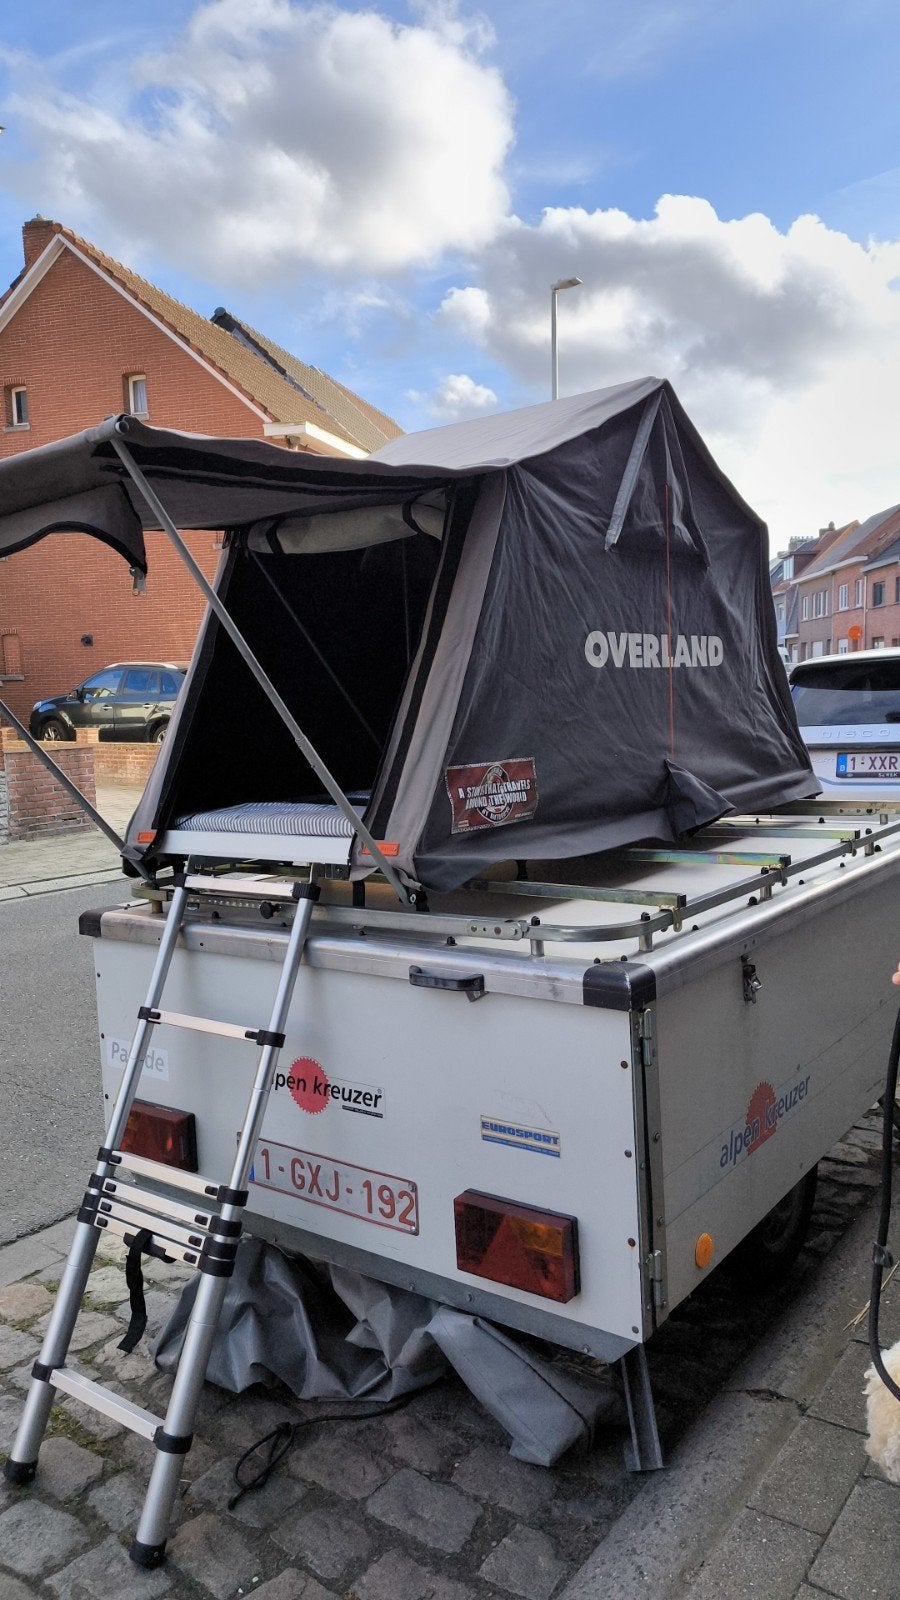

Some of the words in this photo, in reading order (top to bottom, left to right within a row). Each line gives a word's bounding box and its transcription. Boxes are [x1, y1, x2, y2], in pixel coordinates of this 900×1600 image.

[584, 630, 724, 668] OVERLAND
[850, 755, 899, 771] 1-XXR
[458, 788, 465, 799] A
[502, 780, 530, 792] TRAVELS
[489, 794, 504, 806] THE
[504, 791, 527, 804] WORLD
[111, 1041, 165, 1073] Pade
[271, 1072, 307, 1092] pen
[313, 1075, 383, 1108] kreuzer
[481, 1121, 560, 1145] EUROSPORT
[719, 1118, 760, 1168] alpen
[764, 1075, 811, 1131] kreuzer
[260, 1148, 416, 1227] 1-GXJ-192
